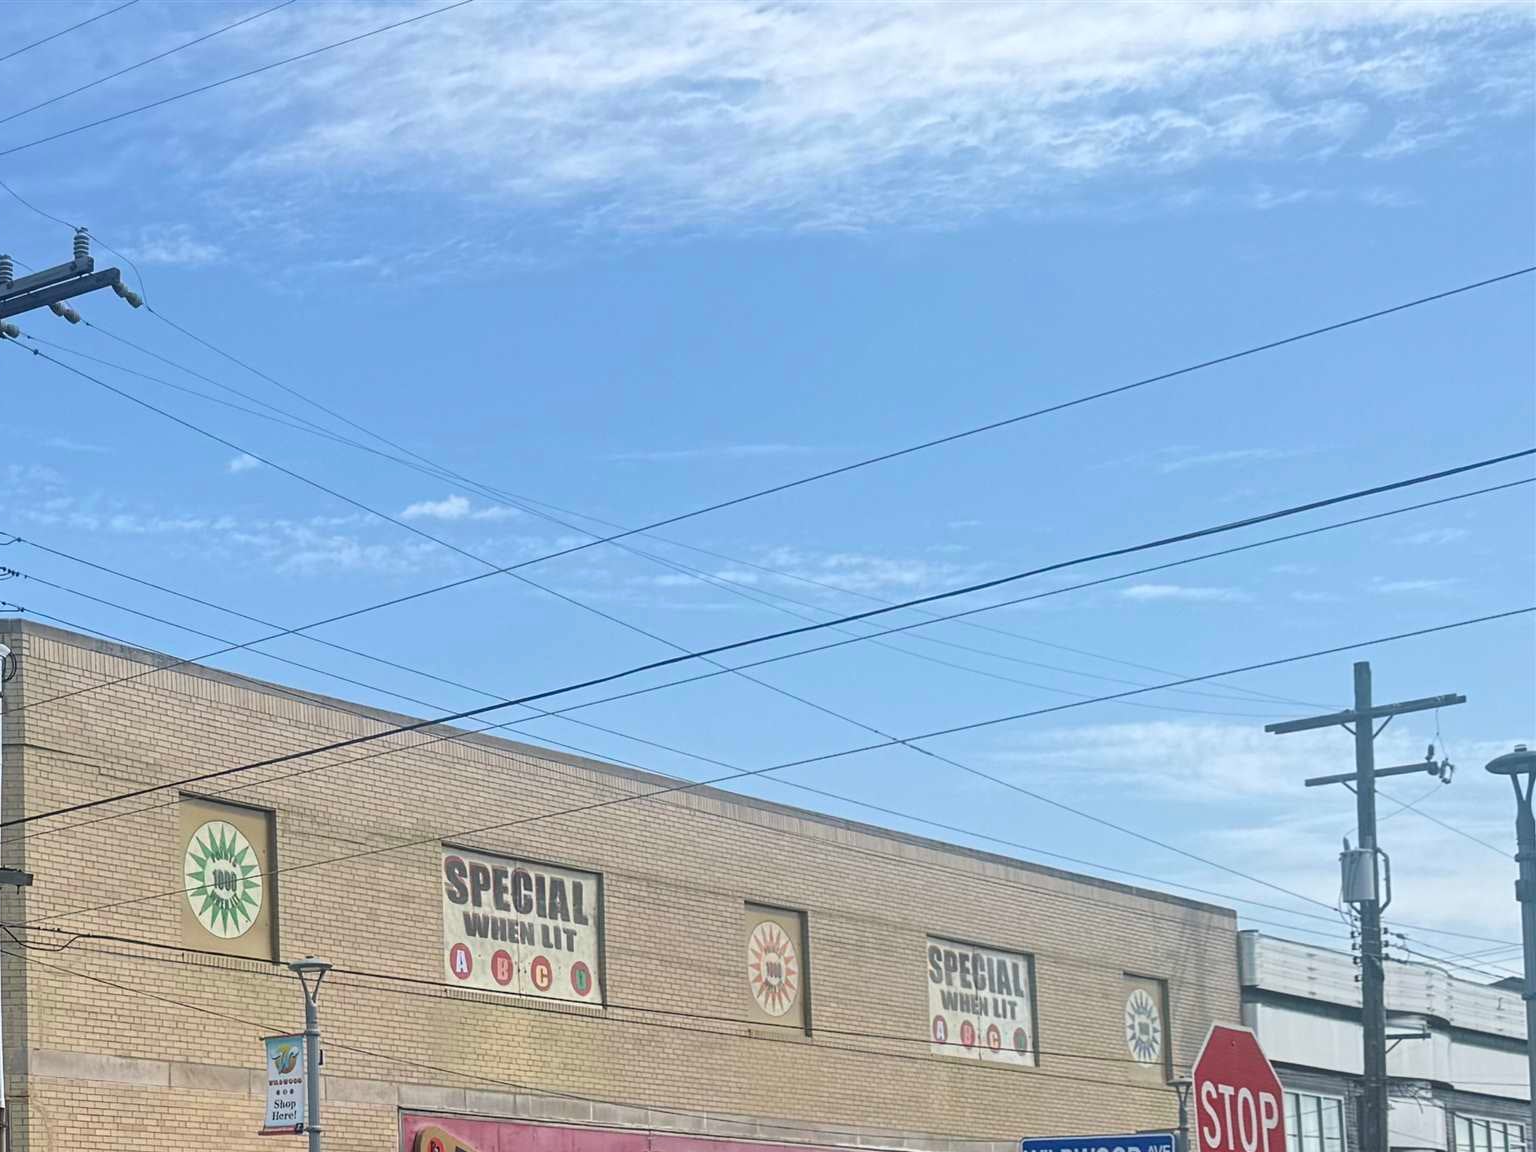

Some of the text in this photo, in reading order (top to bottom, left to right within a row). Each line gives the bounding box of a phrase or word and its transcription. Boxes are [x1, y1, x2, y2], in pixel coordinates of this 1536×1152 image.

[213, 869, 237, 892] 1000
[443, 855, 589, 926] SPECIAL
[463, 911, 577, 953] WHEN LIT
[927, 945, 1025, 998] SPECIAL
[940, 989, 1018, 1020] WHEN LIT
[272, 1110, 297, 1121] Here!
[274, 1099, 296, 1110] Shop
